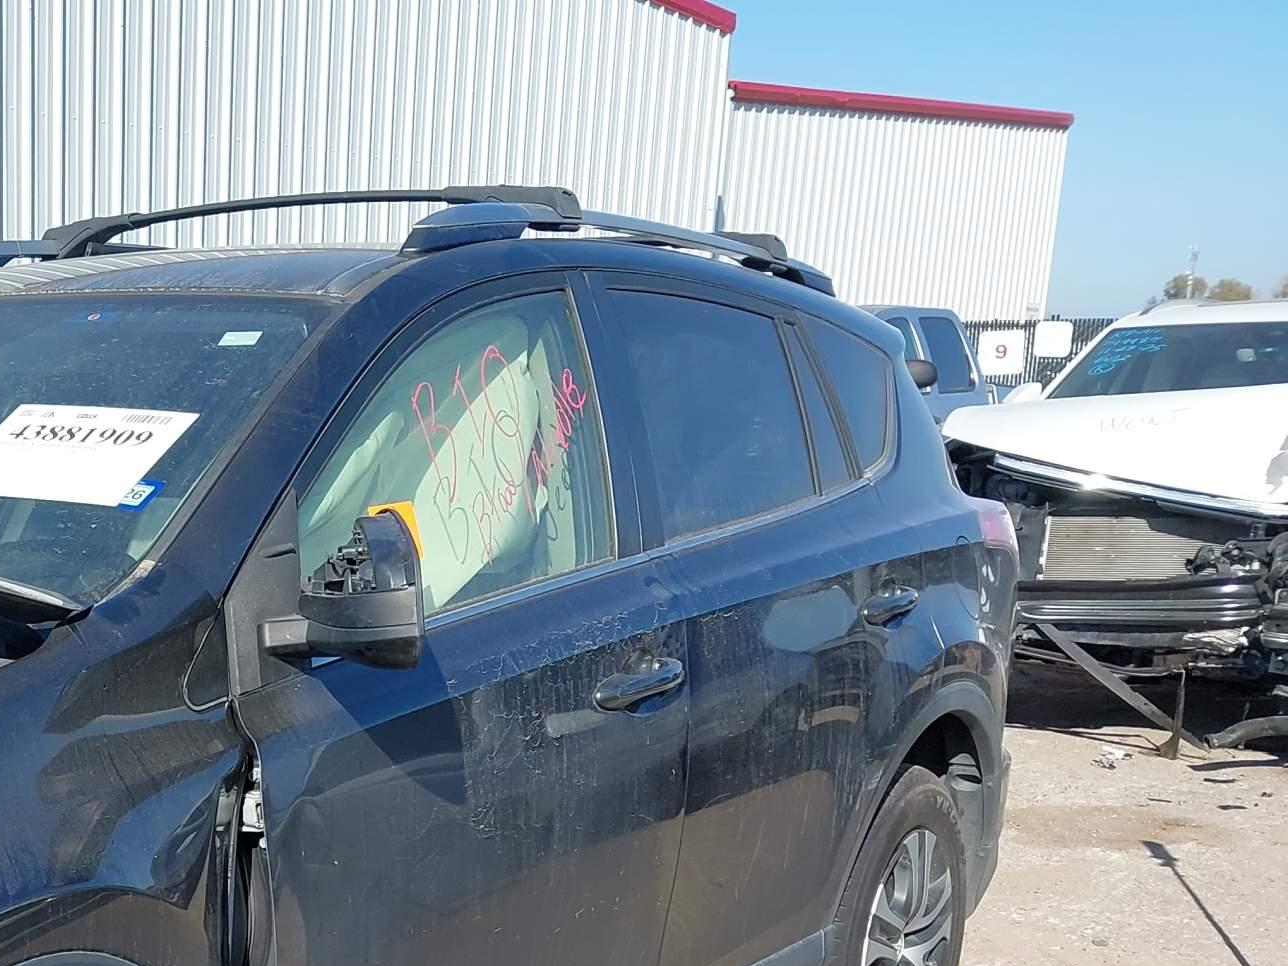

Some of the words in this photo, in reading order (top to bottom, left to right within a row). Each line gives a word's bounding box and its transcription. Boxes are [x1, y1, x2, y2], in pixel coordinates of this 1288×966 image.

[995, 344, 1008, 359] 9
[9, 424, 154, 446] 43881909
[412, 345, 532, 514] BIO
